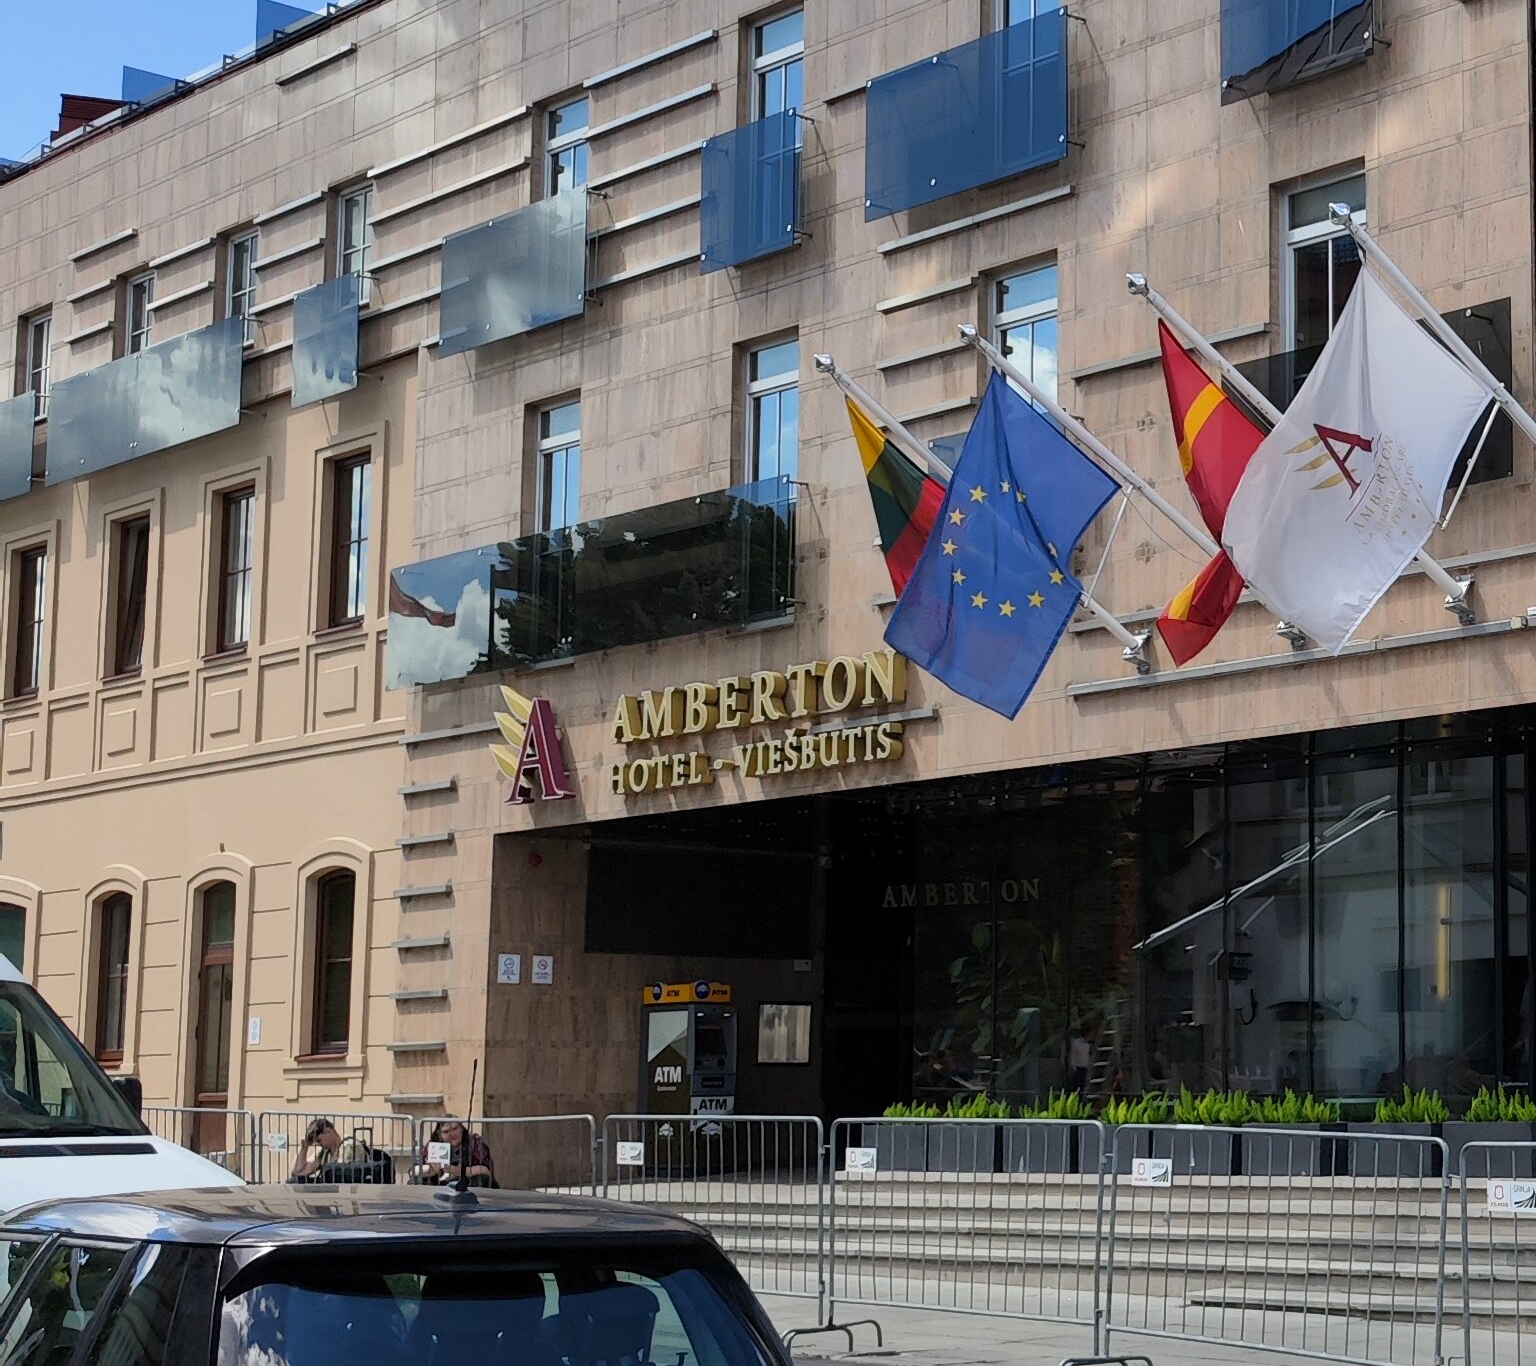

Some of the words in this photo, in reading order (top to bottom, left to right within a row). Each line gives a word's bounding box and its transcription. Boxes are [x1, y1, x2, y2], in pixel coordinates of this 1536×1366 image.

[1353, 435, 1395, 535] AMBRTON
[609, 649, 907, 745] AMBERTON
[608, 751, 716, 795] HOTEL
[732, 722, 904, 779] VIEŠBUTIS
[654, 1066, 682, 1084] ATM
[699, 1098, 728, 1111] ATM
